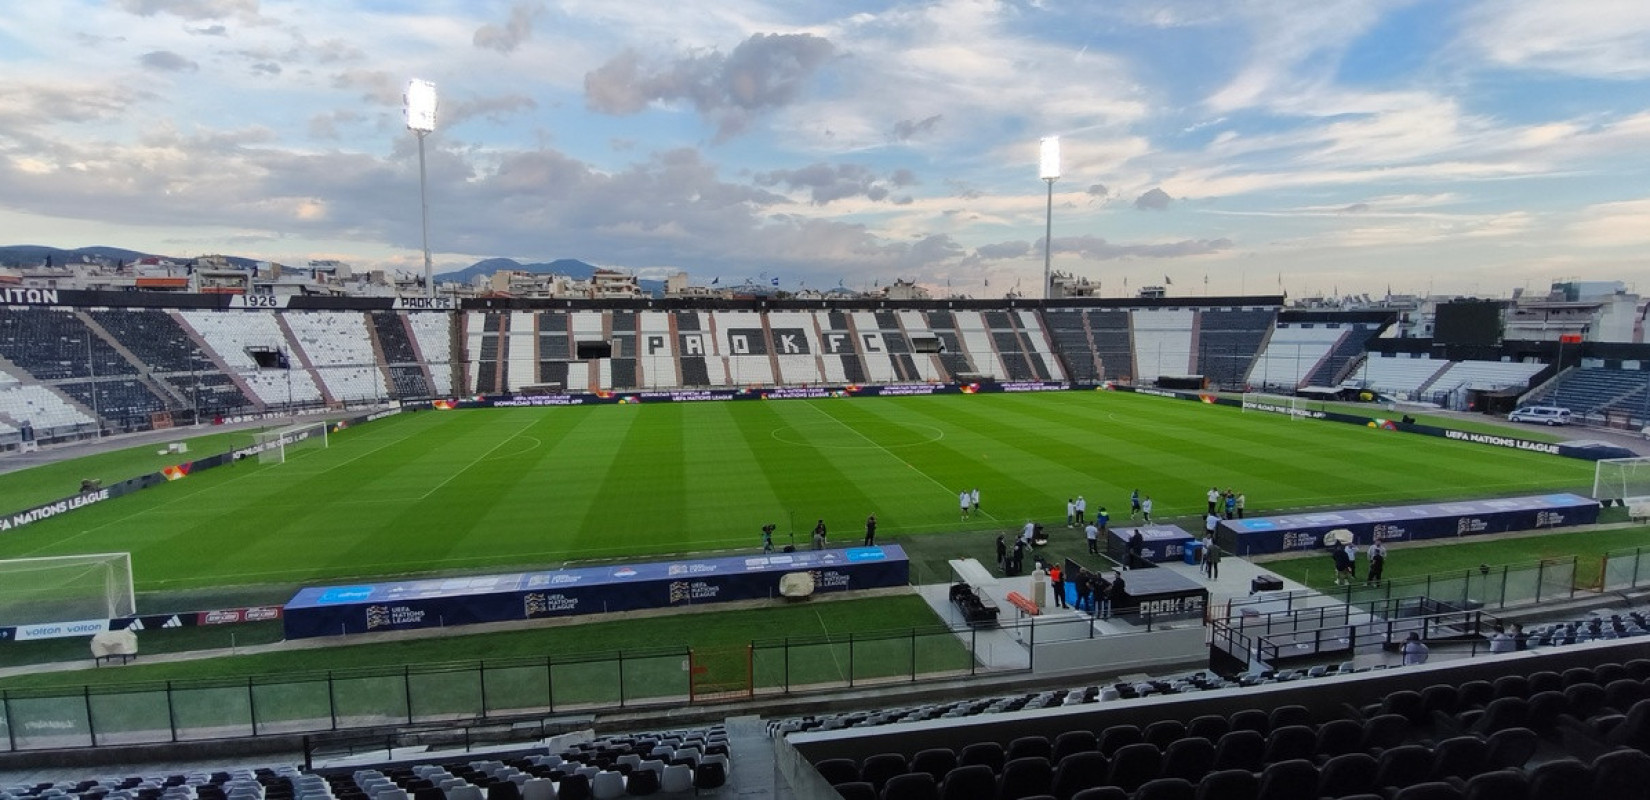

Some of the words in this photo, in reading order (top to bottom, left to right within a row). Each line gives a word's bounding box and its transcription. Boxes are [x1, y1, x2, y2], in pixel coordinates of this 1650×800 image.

[0, 288, 58, 303] ΙΤΩΝ
[241, 295, 277, 306] 1926
[401, 297, 433, 308] PAOK
[436, 298, 450, 308] FC
[649, 334, 799, 355] PAOK
[829, 334, 880, 354] FC
[1445, 430, 1469, 440] UEFA
[1470, 434, 1515, 447] NATIONS
[1516, 440, 1560, 454] LEAGUE
[13, 501, 67, 527] NATIONS
[68, 489, 109, 510] LEAGUE
